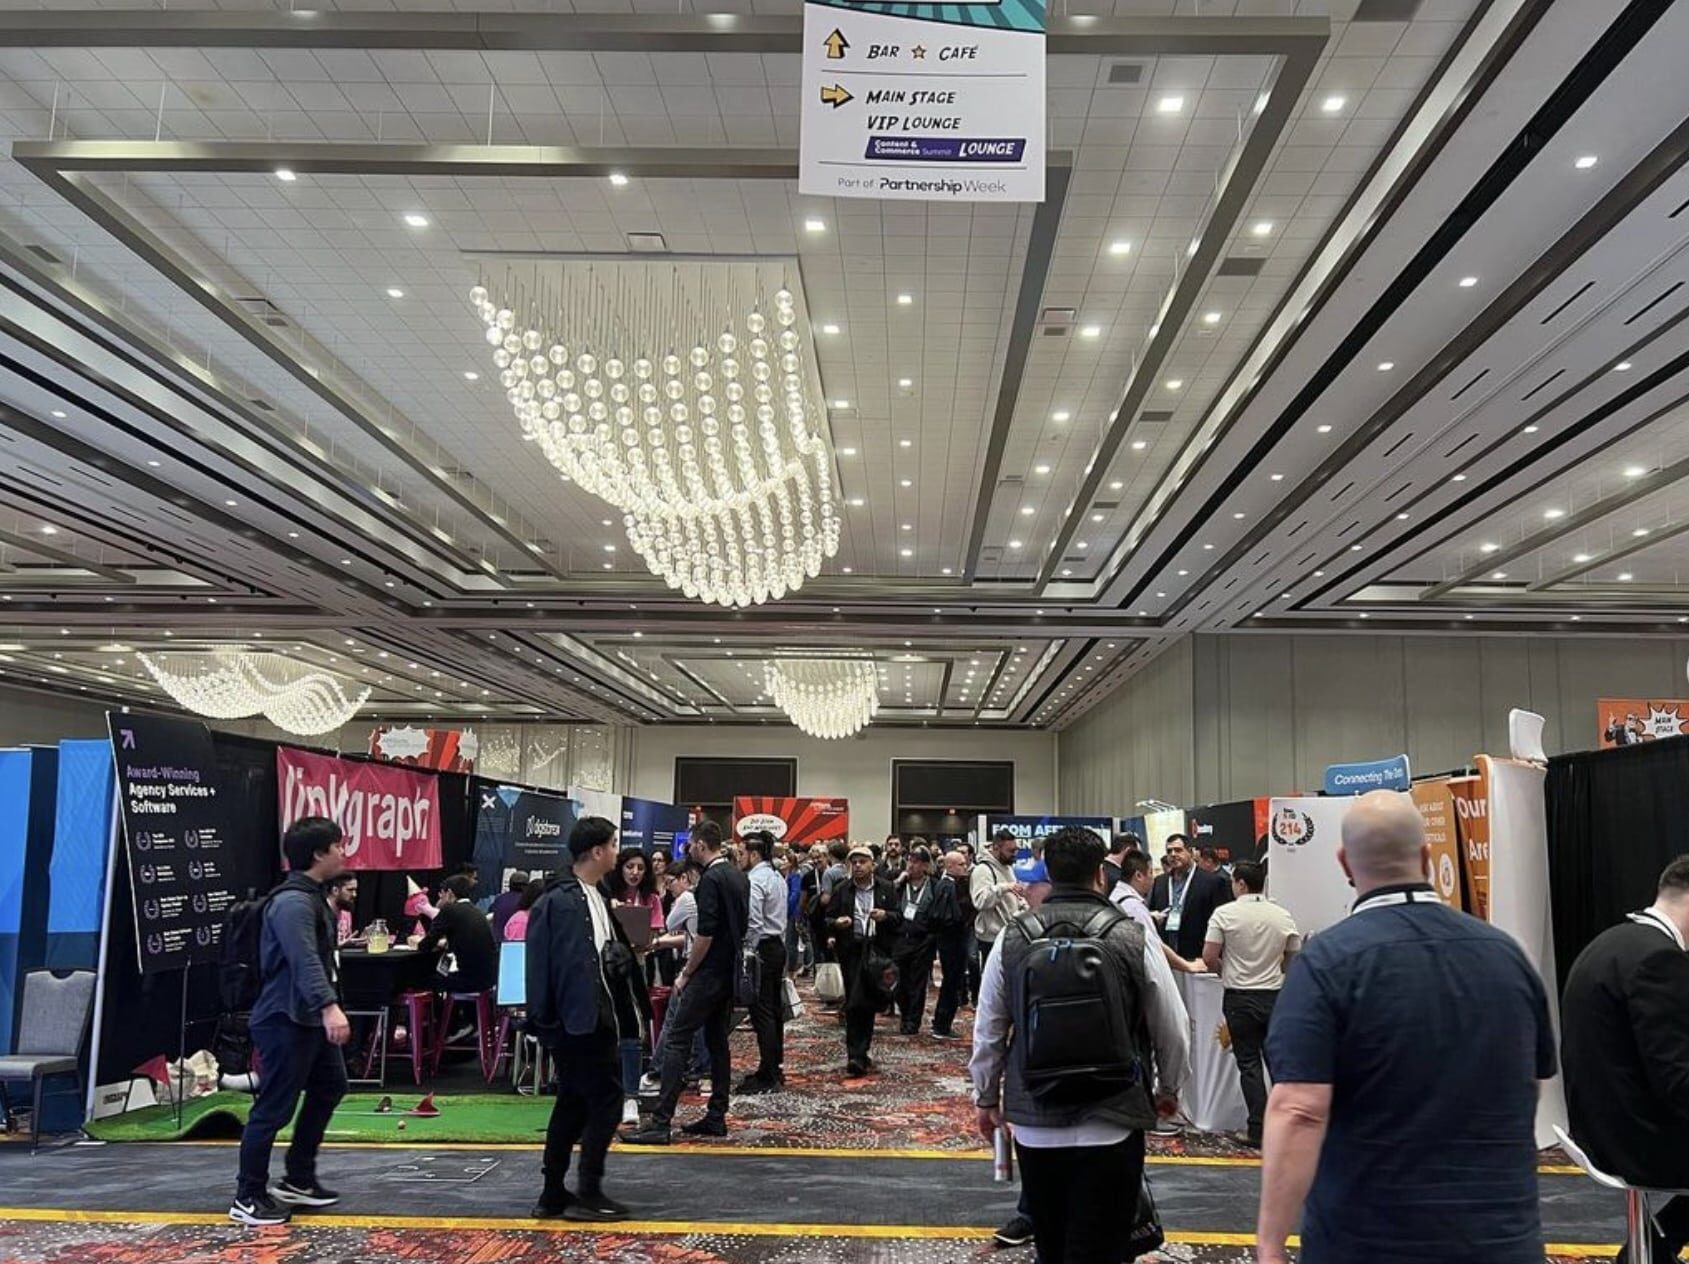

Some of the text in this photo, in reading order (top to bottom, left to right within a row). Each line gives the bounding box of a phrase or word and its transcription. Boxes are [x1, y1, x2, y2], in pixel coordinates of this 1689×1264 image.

[866, 45, 900, 60] BAR
[865, 90, 957, 106] MAIN STAGE
[866, 115, 962, 131] VIP LOUNGE
[874, 139, 918, 148] Content &
[874, 147, 921, 156] Commerce
[958, 142, 1016, 158] LOUNGE
[837, 177, 860, 188] Part
[863, 178, 875, 189] of
[126, 764, 200, 782] Award-Winning
[1334, 770, 1383, 786] Connecting
[129, 782, 167, 799] Agency
[167, 782, 209, 797] Services
[130, 800, 177, 815] Software
[1456, 797, 1488, 818] Our
[1280, 821, 1302, 836] 214
